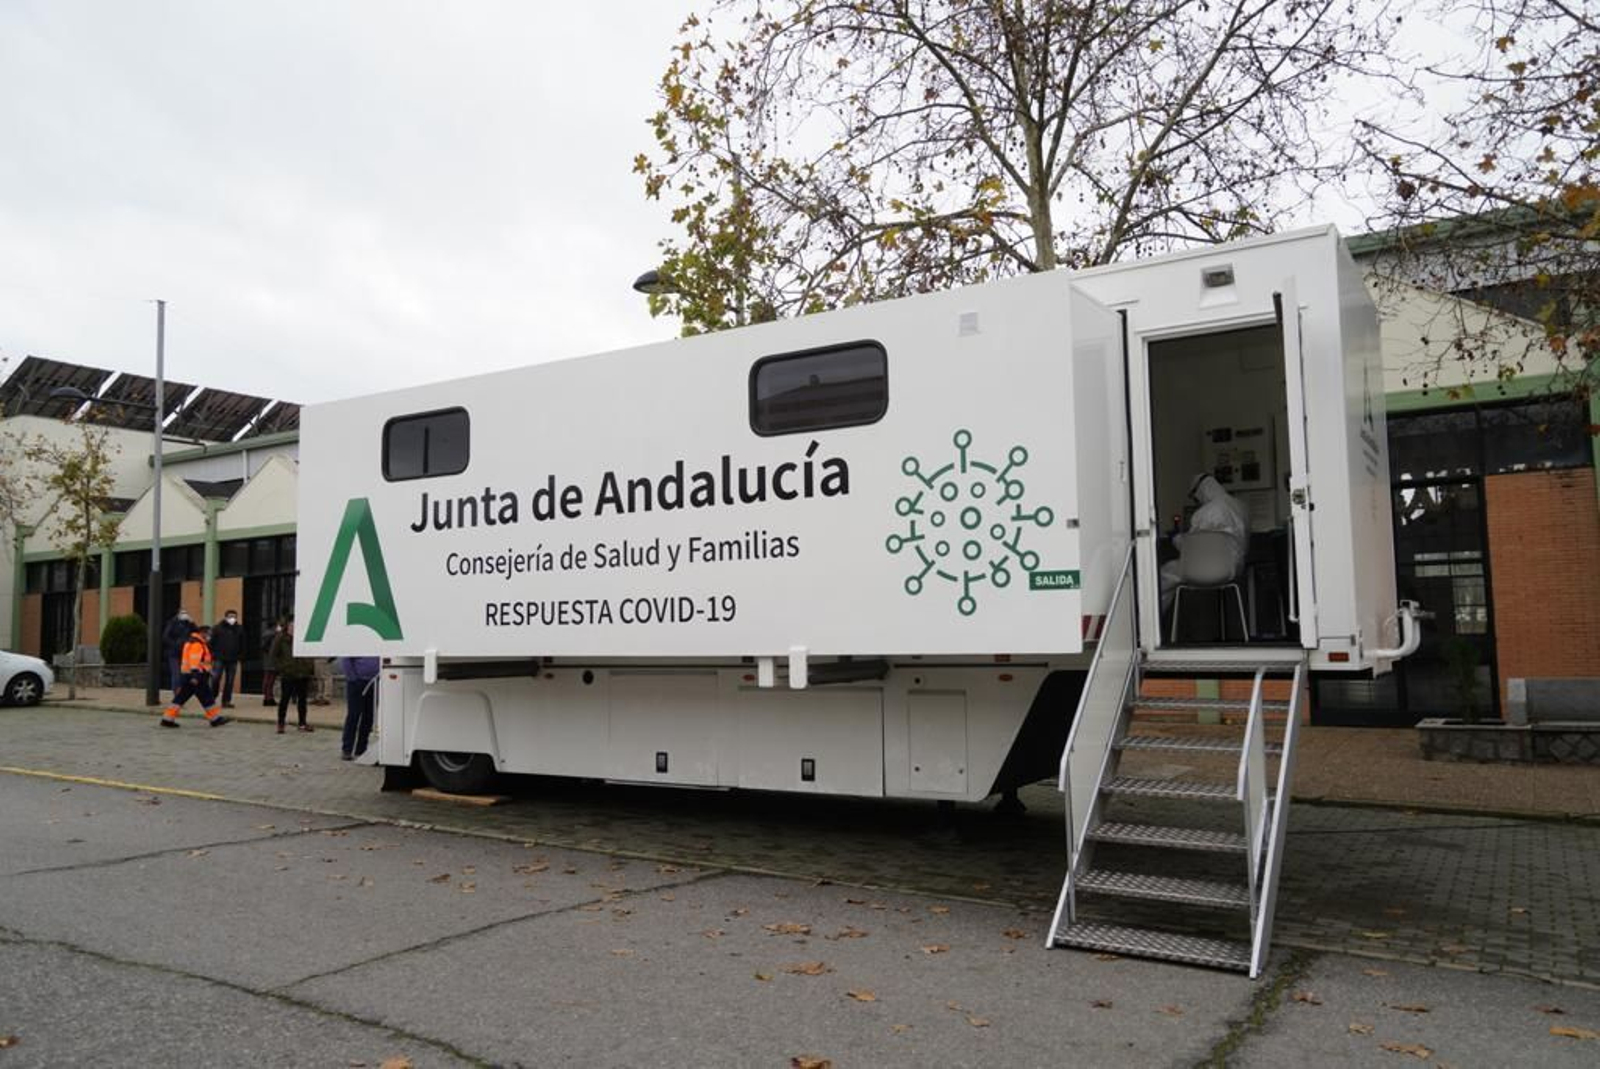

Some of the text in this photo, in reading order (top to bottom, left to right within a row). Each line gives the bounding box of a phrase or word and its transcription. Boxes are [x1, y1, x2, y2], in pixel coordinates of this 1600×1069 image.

[410, 439, 850, 534] Junta de Andalucía
[446, 529, 800, 581] Consejería de Salud y Familias
[1035, 574, 1073, 587] SALIDA
[485, 594, 737, 627] RESPUESTA COVID-19
